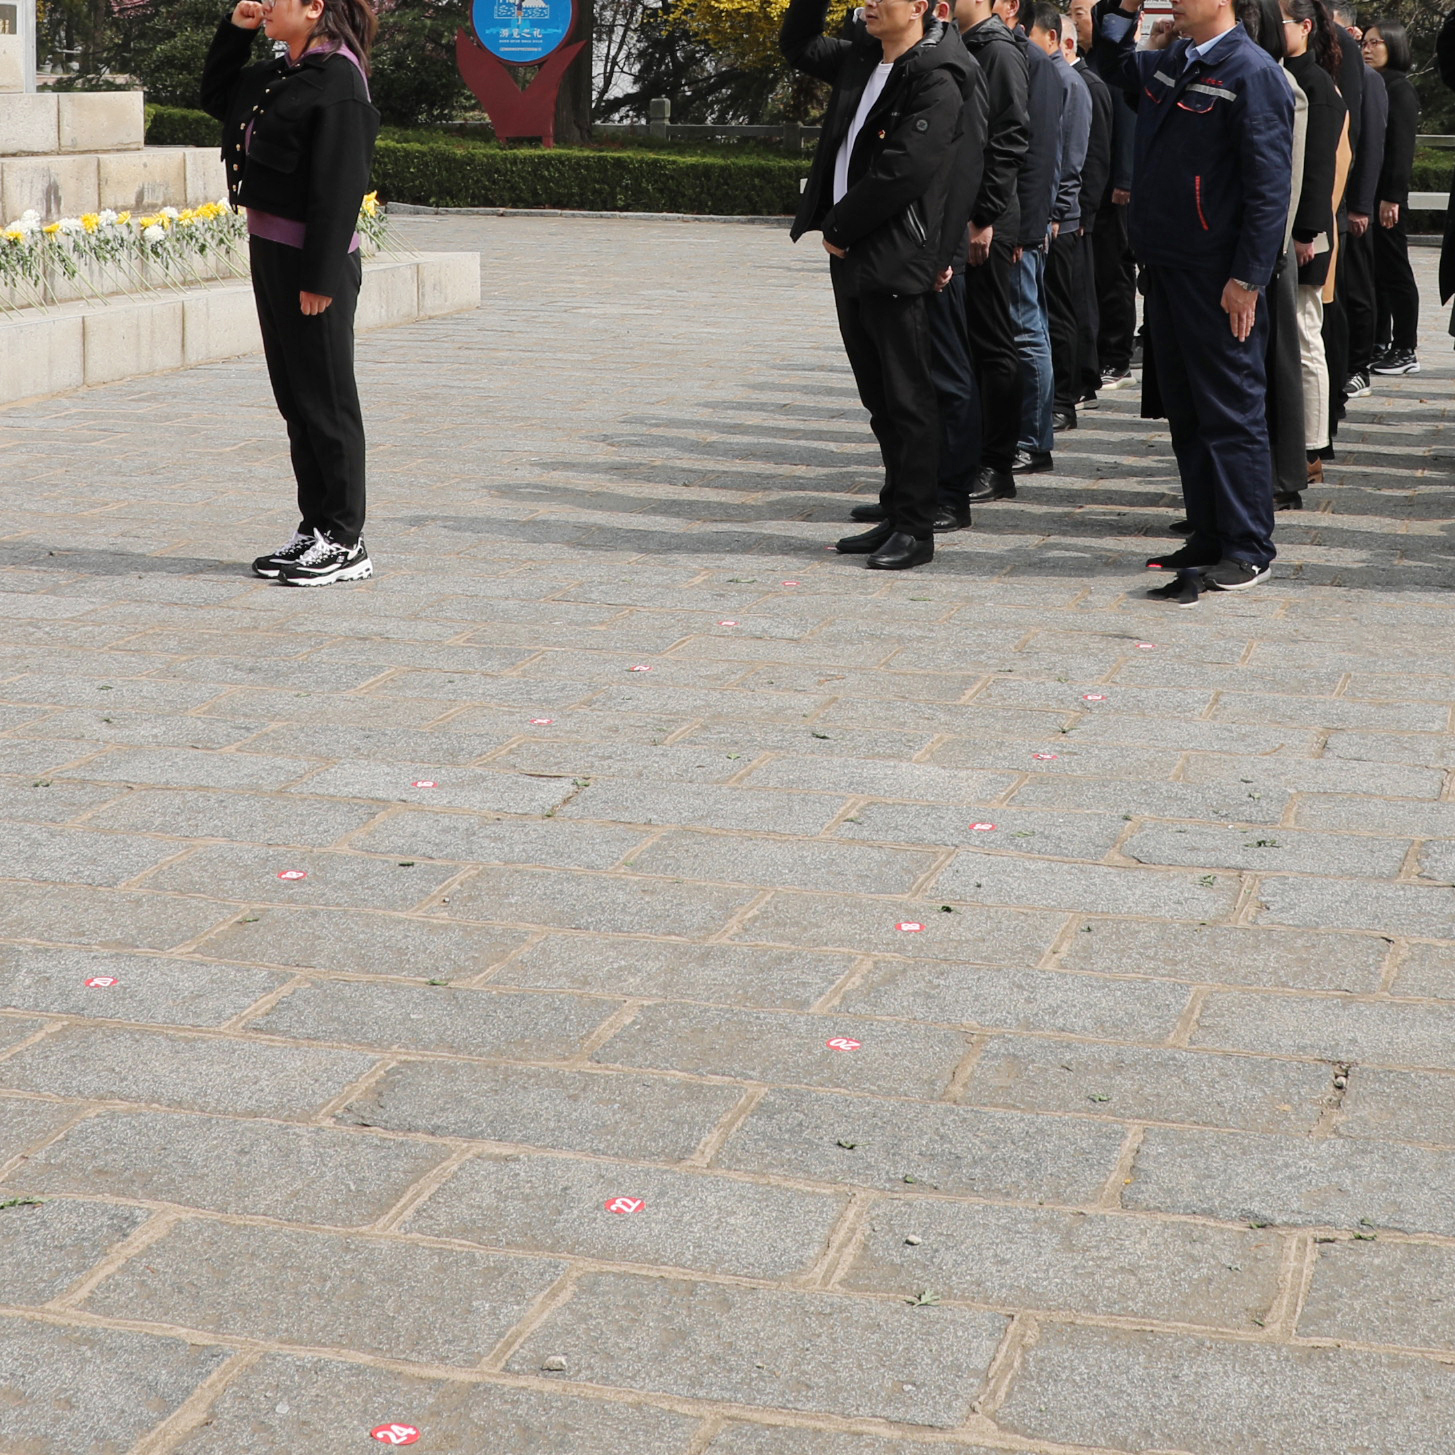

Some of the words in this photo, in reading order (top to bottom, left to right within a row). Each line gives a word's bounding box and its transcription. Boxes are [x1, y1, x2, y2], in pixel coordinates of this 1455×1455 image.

[901, 922, 920, 932] 18
[90, 978, 113, 987] 20
[830, 1038, 861, 1051] 20
[611, 1198, 642, 1213] 22
[376, 1424, 417, 1445] 24
